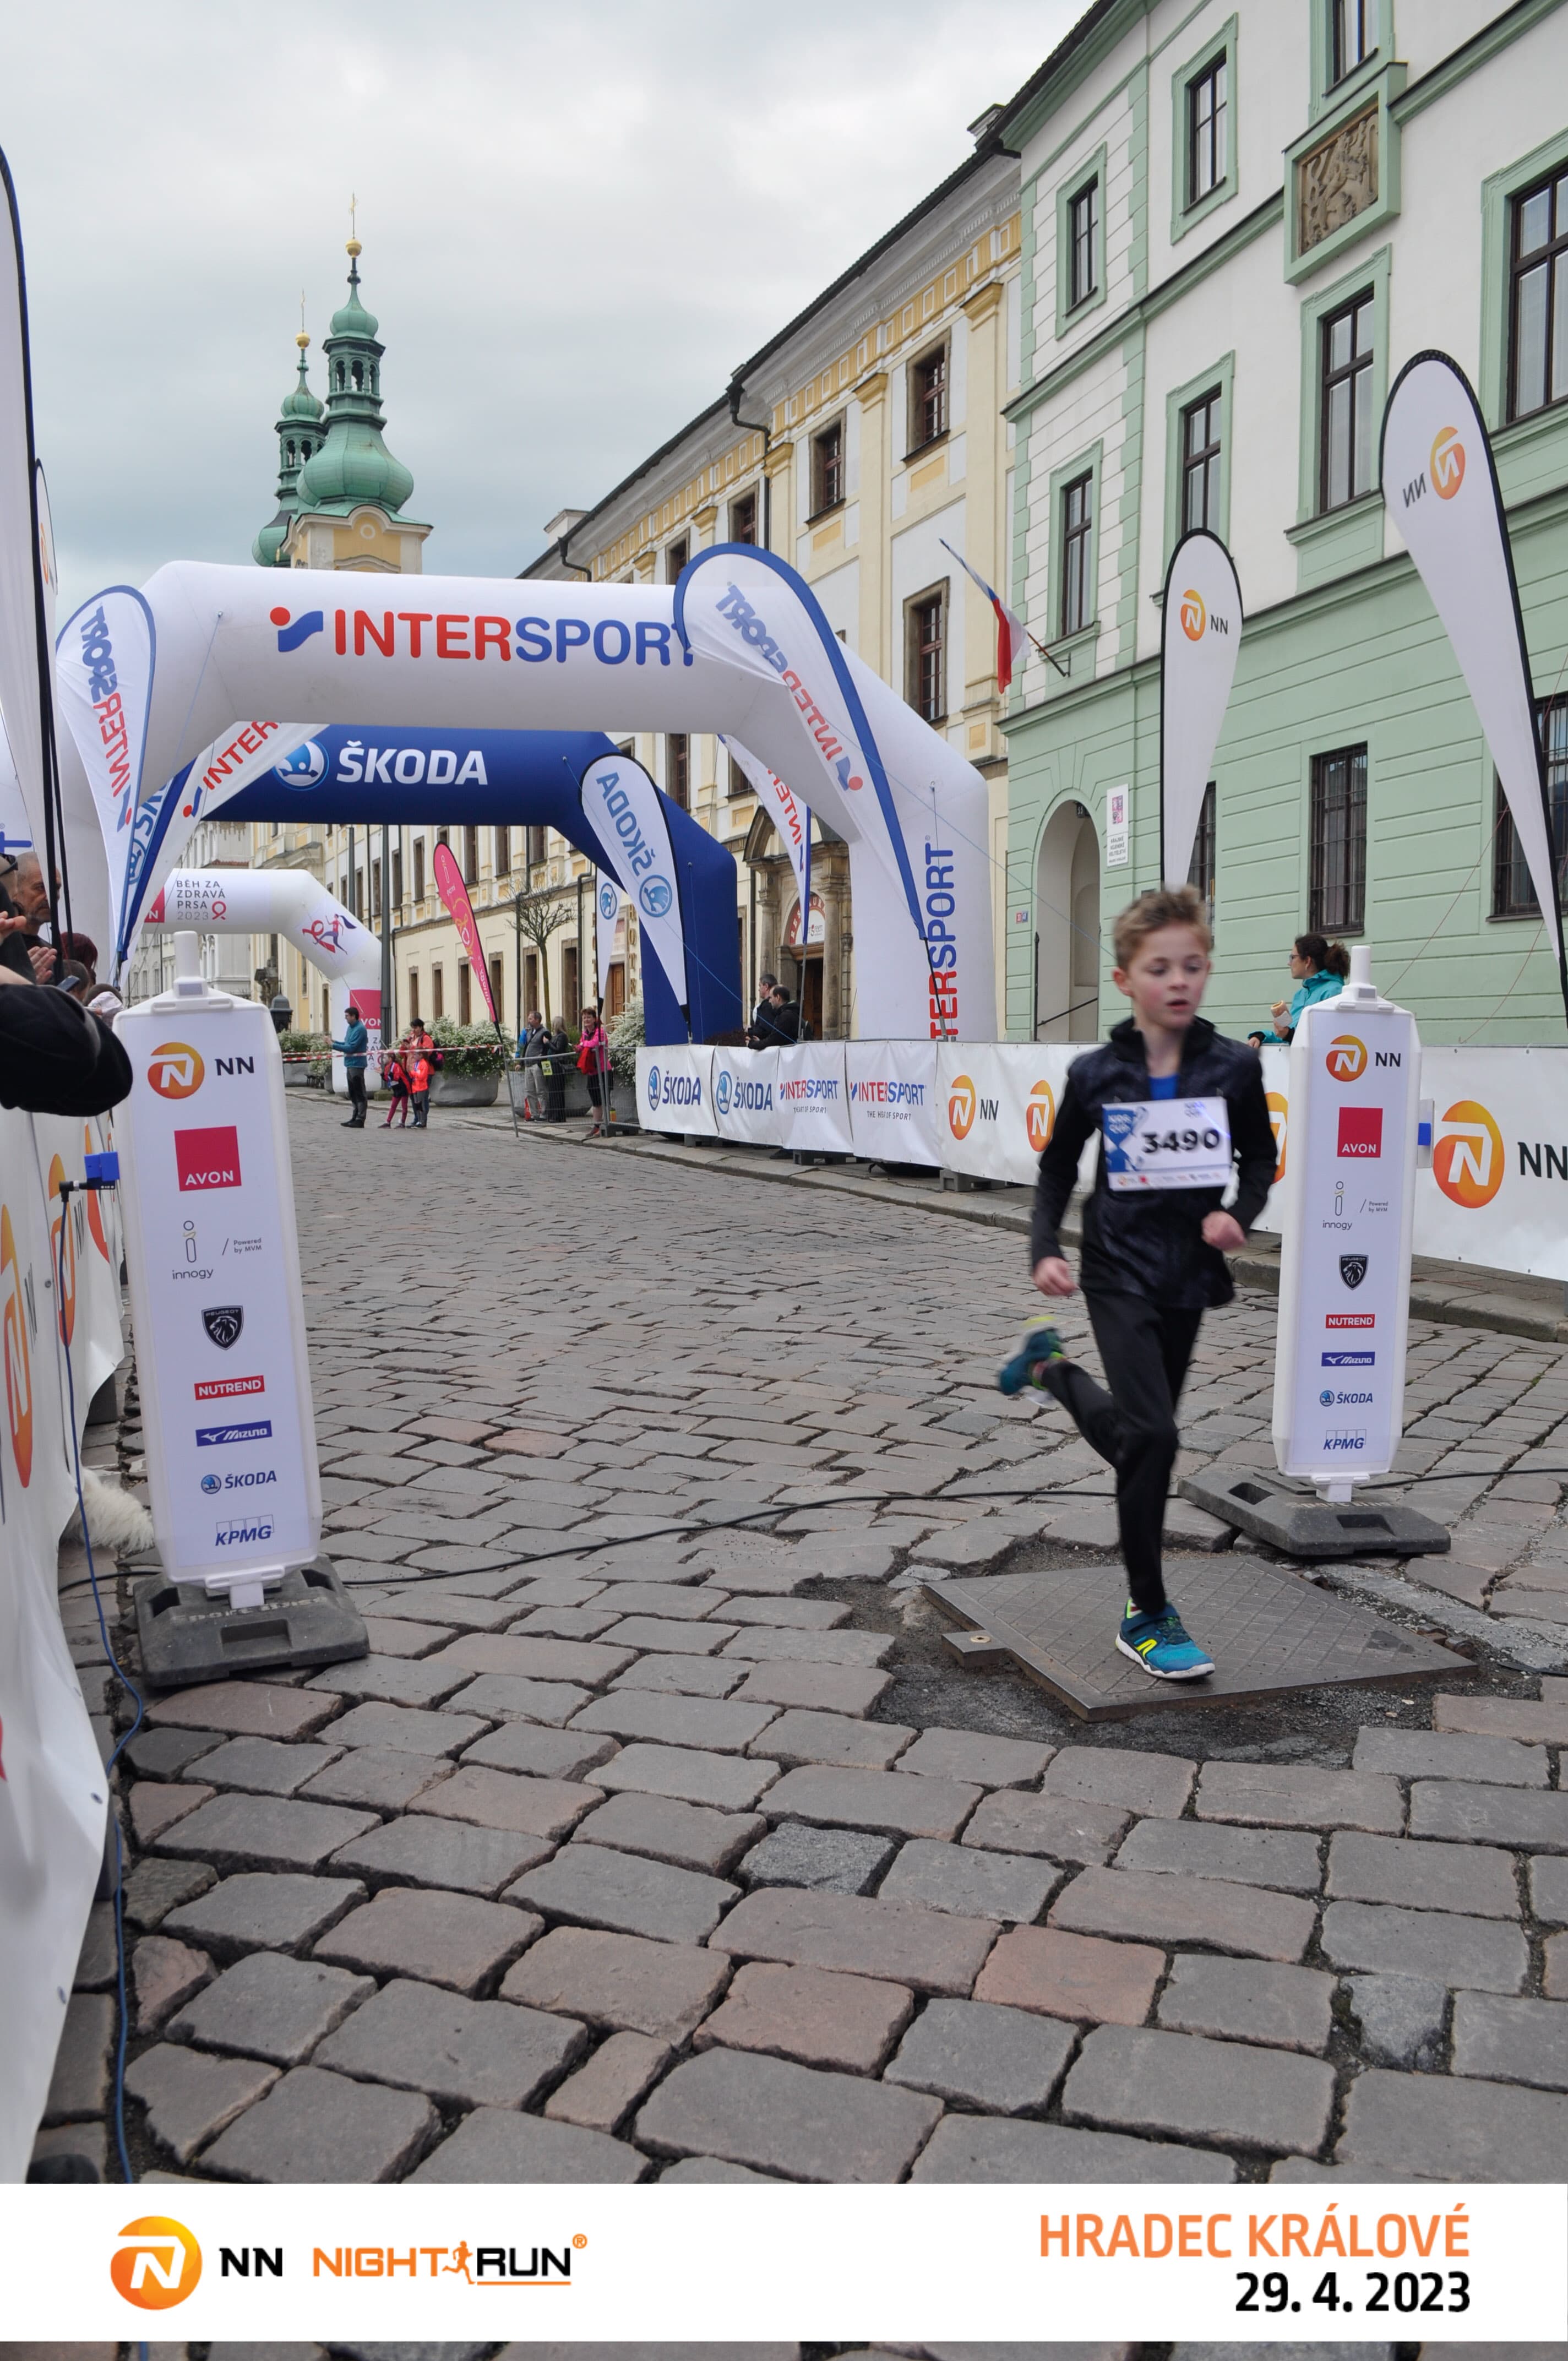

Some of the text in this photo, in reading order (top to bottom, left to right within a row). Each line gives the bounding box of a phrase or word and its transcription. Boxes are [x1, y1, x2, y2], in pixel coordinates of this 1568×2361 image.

[1211, 614, 1228, 634] NN
[336, 740, 488, 785] ŠKODA
[177, 879, 199, 888] BĚH
[177, 889, 225, 898] ZDRAVÁ
[177, 901, 207, 909] PRSA
[177, 911, 209, 920] 2023
[925, 842, 959, 1040] TERSPORT
[215, 1056, 254, 1075] NN
[1375, 1052, 1401, 1067] NN
[662, 1070, 701, 1105] ŠKODA
[733, 1077, 773, 1111] ŠKODA
[858, 1081, 924, 1106] INTERSPORT
[980, 1099, 999, 1120] NN
[1141, 1128, 1220, 1154] 3490
[1342, 1144, 1376, 1154] AVON
[1517, 1142, 1568, 1180] NN
[186, 1170, 234, 1185] AVON
[1322, 1220, 1353, 1230] innogy
[172, 1269, 214, 1280] innogy
[1329, 1317, 1373, 1325] NUTREND
[198, 1379, 262, 1396] NUTREND
[1336, 1392, 1373, 1403] ŠKODA
[1323, 1437, 1364, 1450] KPMG
[224, 1470, 276, 1489] ŠKODA
[215, 1525, 271, 1546] KPMG
